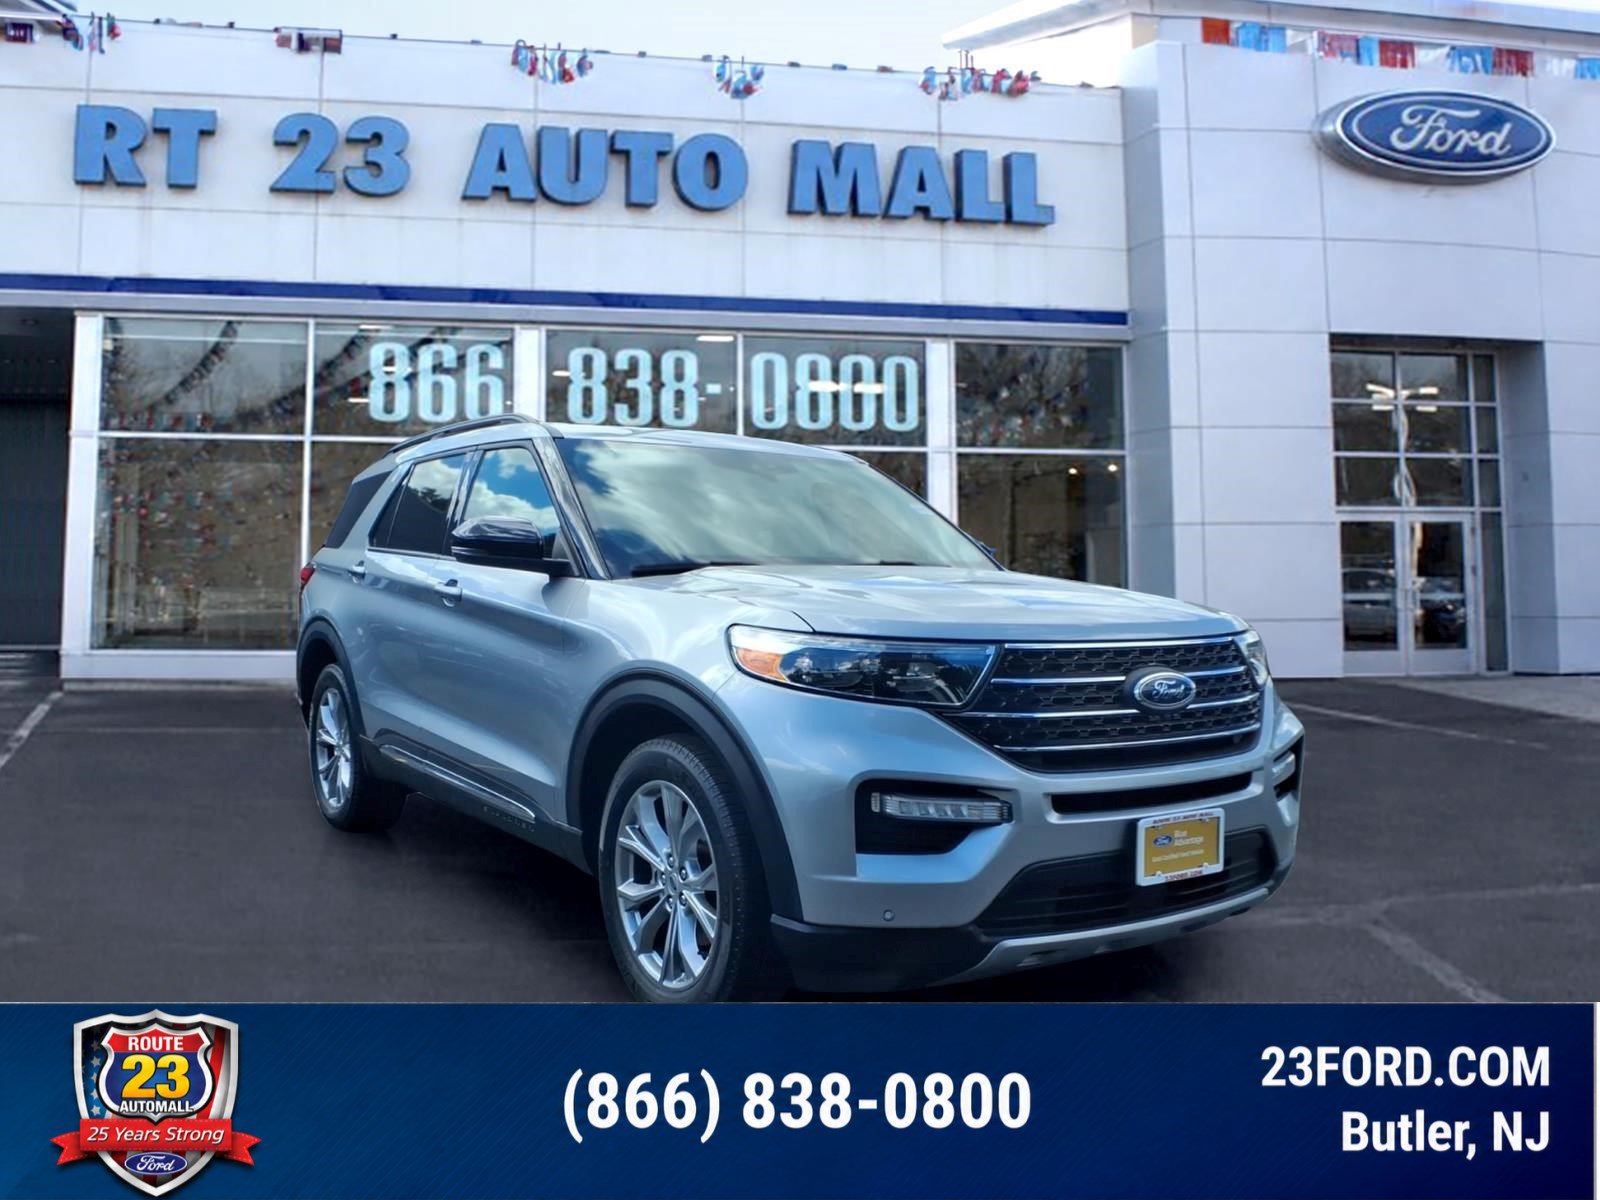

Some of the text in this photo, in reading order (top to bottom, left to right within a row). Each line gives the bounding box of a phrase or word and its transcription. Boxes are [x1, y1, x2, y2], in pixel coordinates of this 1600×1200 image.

[73, 104, 1056, 228] RT 23 AUTO MALL
[1389, 104, 1513, 155] Ford
[368, 341, 507, 423] 866
